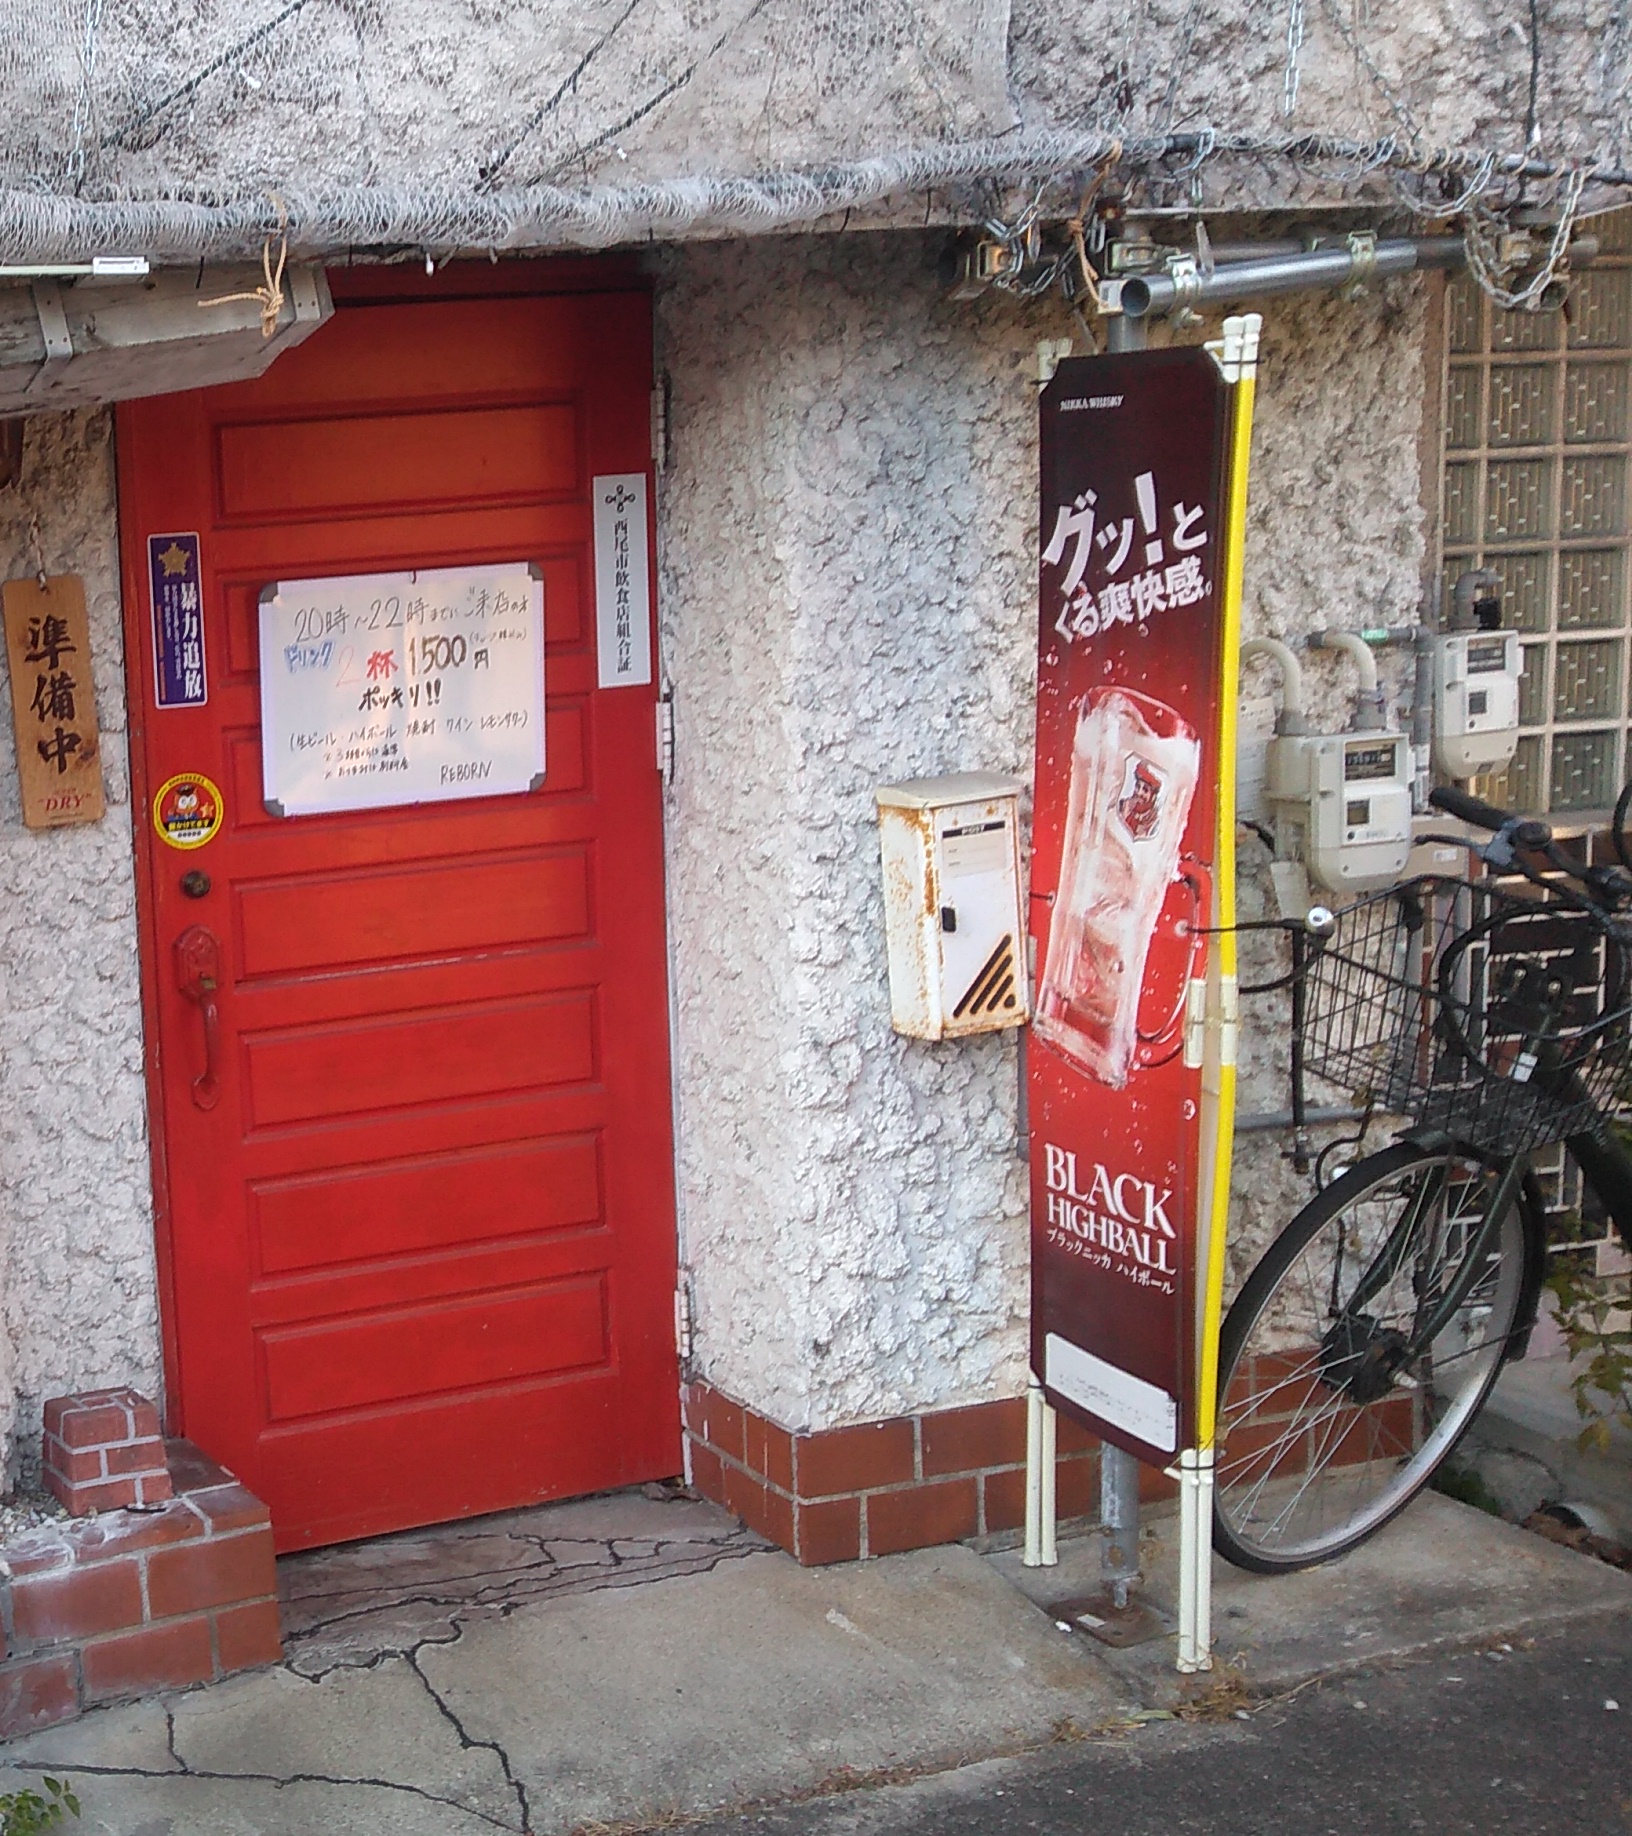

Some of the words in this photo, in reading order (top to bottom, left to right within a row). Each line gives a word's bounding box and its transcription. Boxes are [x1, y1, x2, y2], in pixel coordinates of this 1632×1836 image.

[180, 580, 203, 700] 暴力追放
[614, 517, 632, 675] 西尾市飲食店組合証
[24, 613, 83, 775] 準備中
[440, 760, 493, 785] REBORN
[1044, 1143, 1176, 1240] BLACK
[1047, 1193, 1178, 1276] HIGHBALL
[1047, 1227, 1113, 1270] ブラックニッカ
[1116, 1262, 1176, 1296] ハイボール
